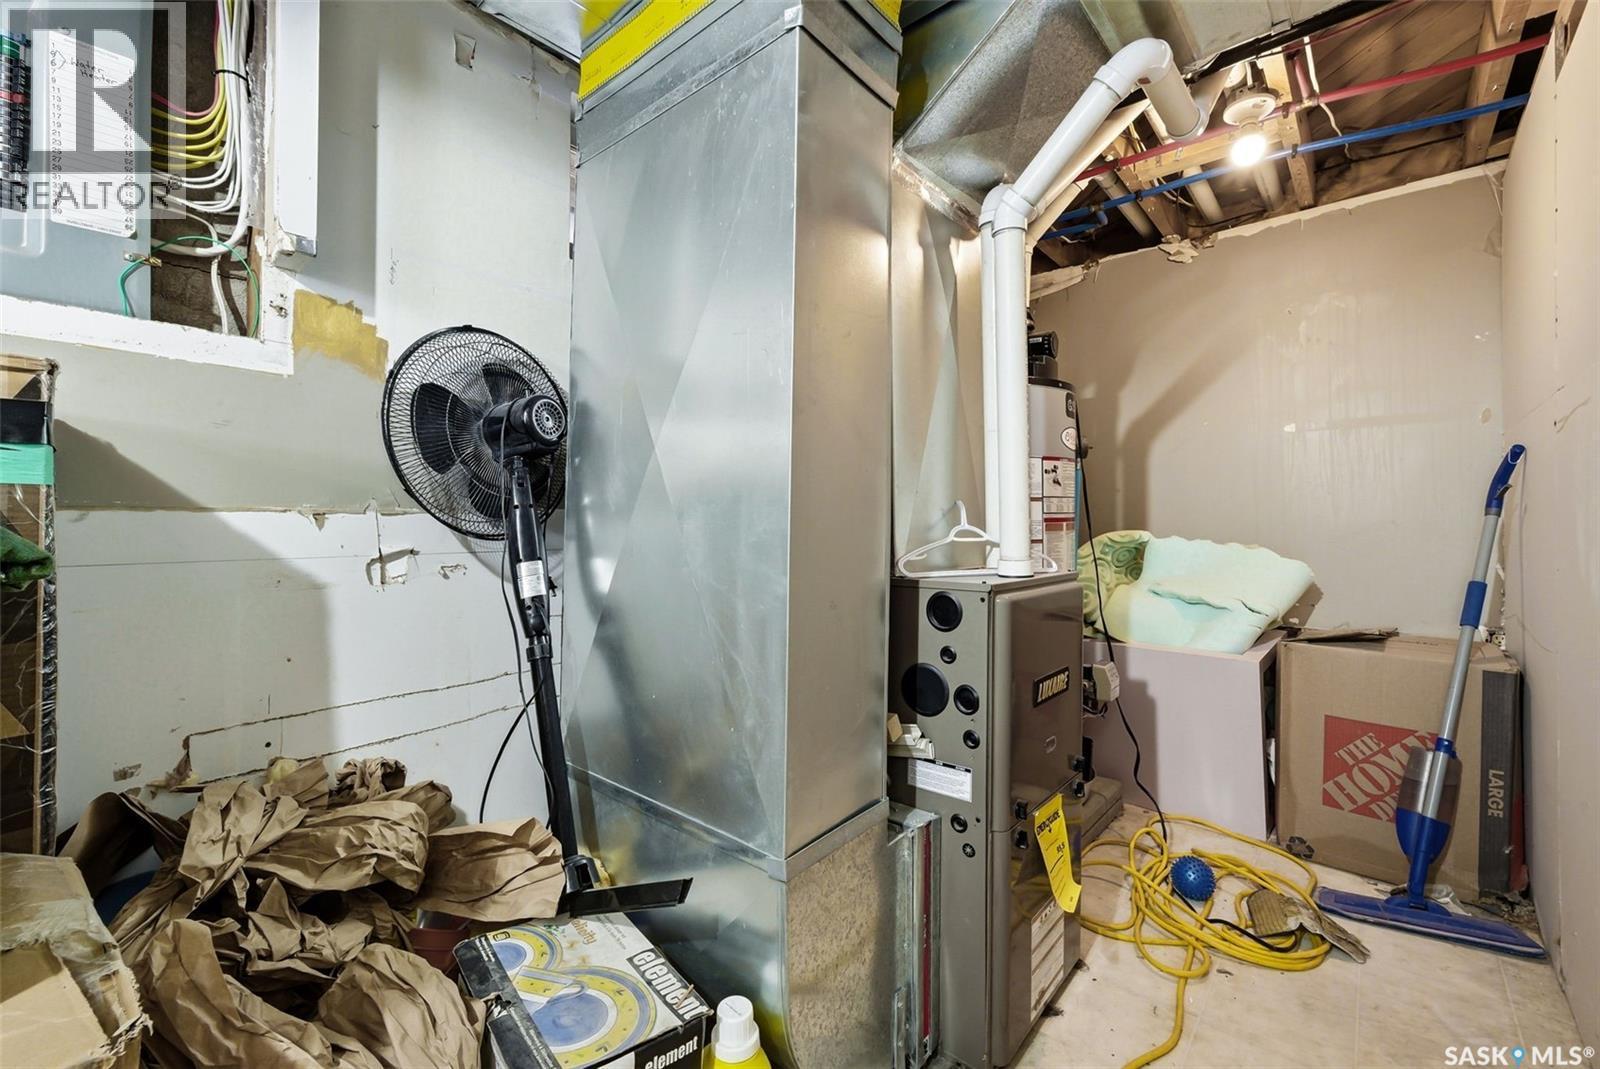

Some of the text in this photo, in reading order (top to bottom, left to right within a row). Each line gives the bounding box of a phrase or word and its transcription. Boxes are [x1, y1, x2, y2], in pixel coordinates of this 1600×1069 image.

[1334, 732, 1386, 767] THE
[1487, 769, 1505, 818] LARGE
[632, 951, 710, 1020] element
[645, 1035, 699, 1069] element
